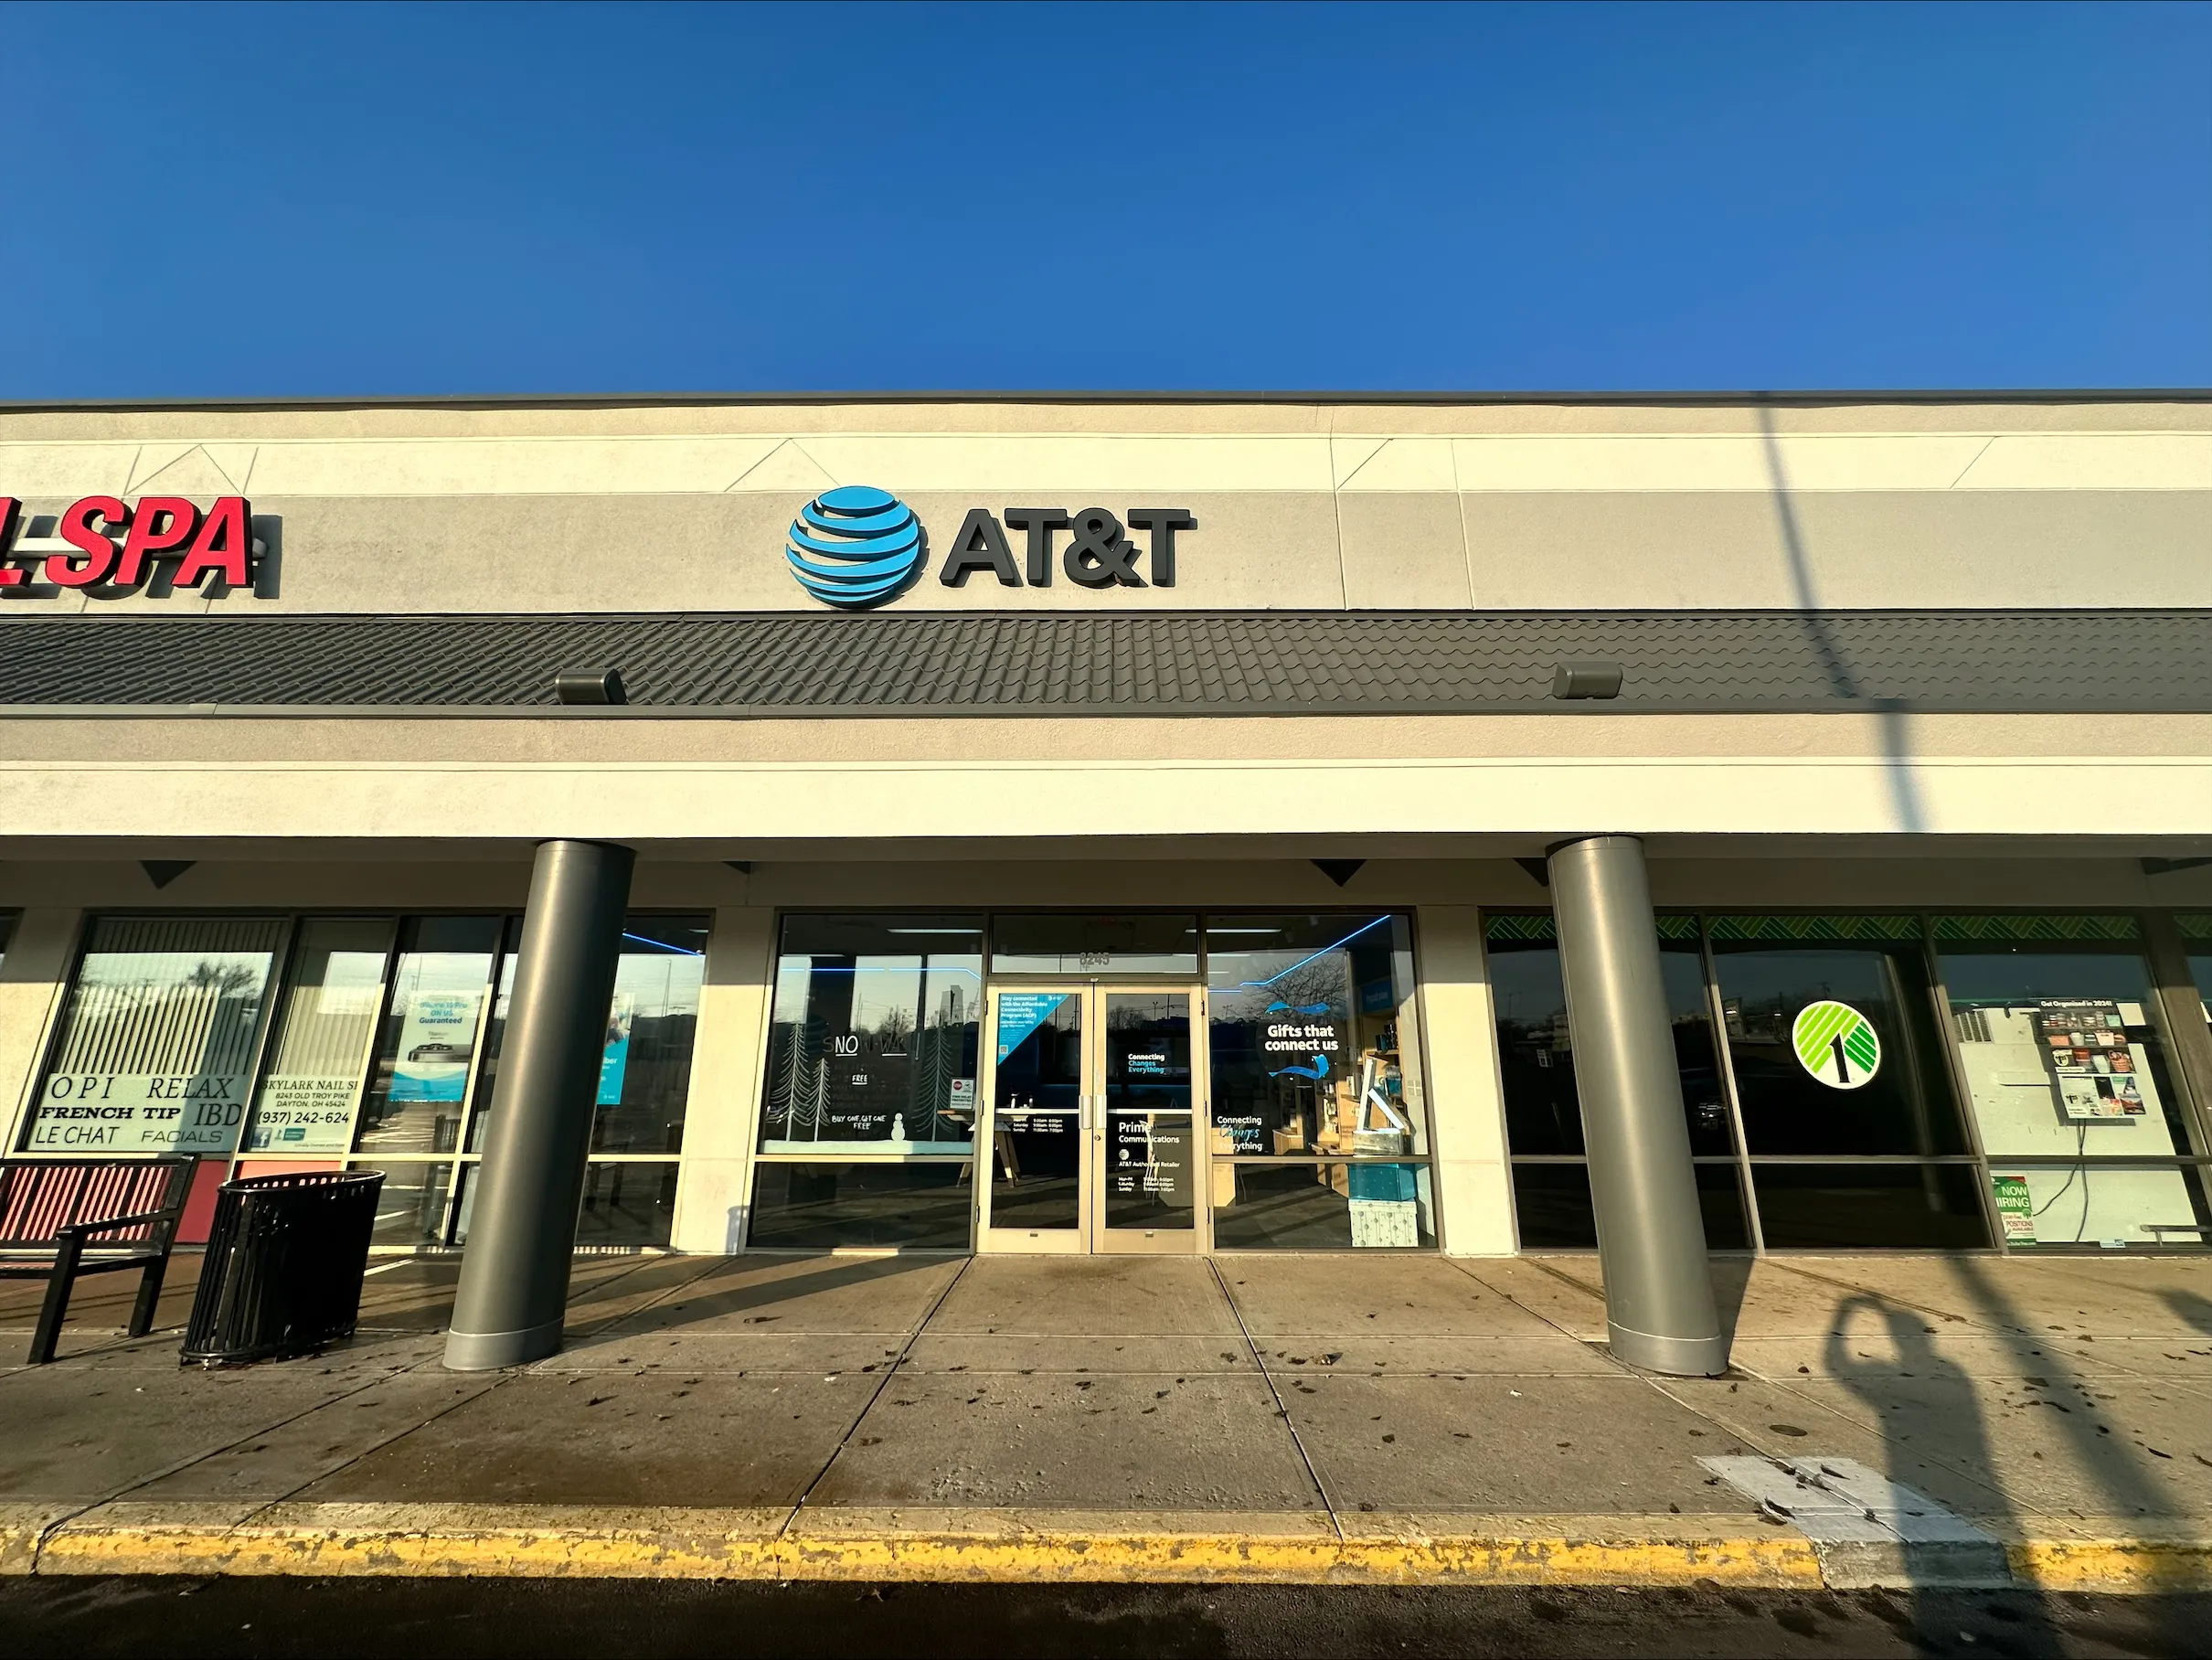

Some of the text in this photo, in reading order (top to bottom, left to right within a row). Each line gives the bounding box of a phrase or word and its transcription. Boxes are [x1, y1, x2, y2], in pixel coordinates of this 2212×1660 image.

[45, 495, 253, 588] SPA
[940, 507, 1191, 588] AT&T
[1079, 952, 1110, 965] 8245
[1267, 1024, 1335, 1038] Gifts that
[1264, 1038, 1339, 1051] connect us
[1127, 1053, 1165, 1061] Connecting
[852, 1074, 867, 1082] FREE
[146, 1077, 234, 1099] RELAX
[261, 1080, 314, 1090] SKYLARK
[316, 1080, 345, 1090] NAIL
[38, 1107, 181, 1120] FRENCH TIP
[193, 1102, 242, 1126] IBD
[257, 1112, 291, 1125] (937)
[1217, 1115, 1262, 1125] Connecting
[1118, 1122, 1152, 1133] Prime
[1220, 1124, 1260, 1141] Changes
[36, 1125, 121, 1144] LE CHAT
[141, 1130, 223, 1143] FACIALS
[1118, 1134, 1180, 1144] Commuications
[1229, 1142, 1263, 1152] rything
[2001, 1186, 2027, 1196] NOW
